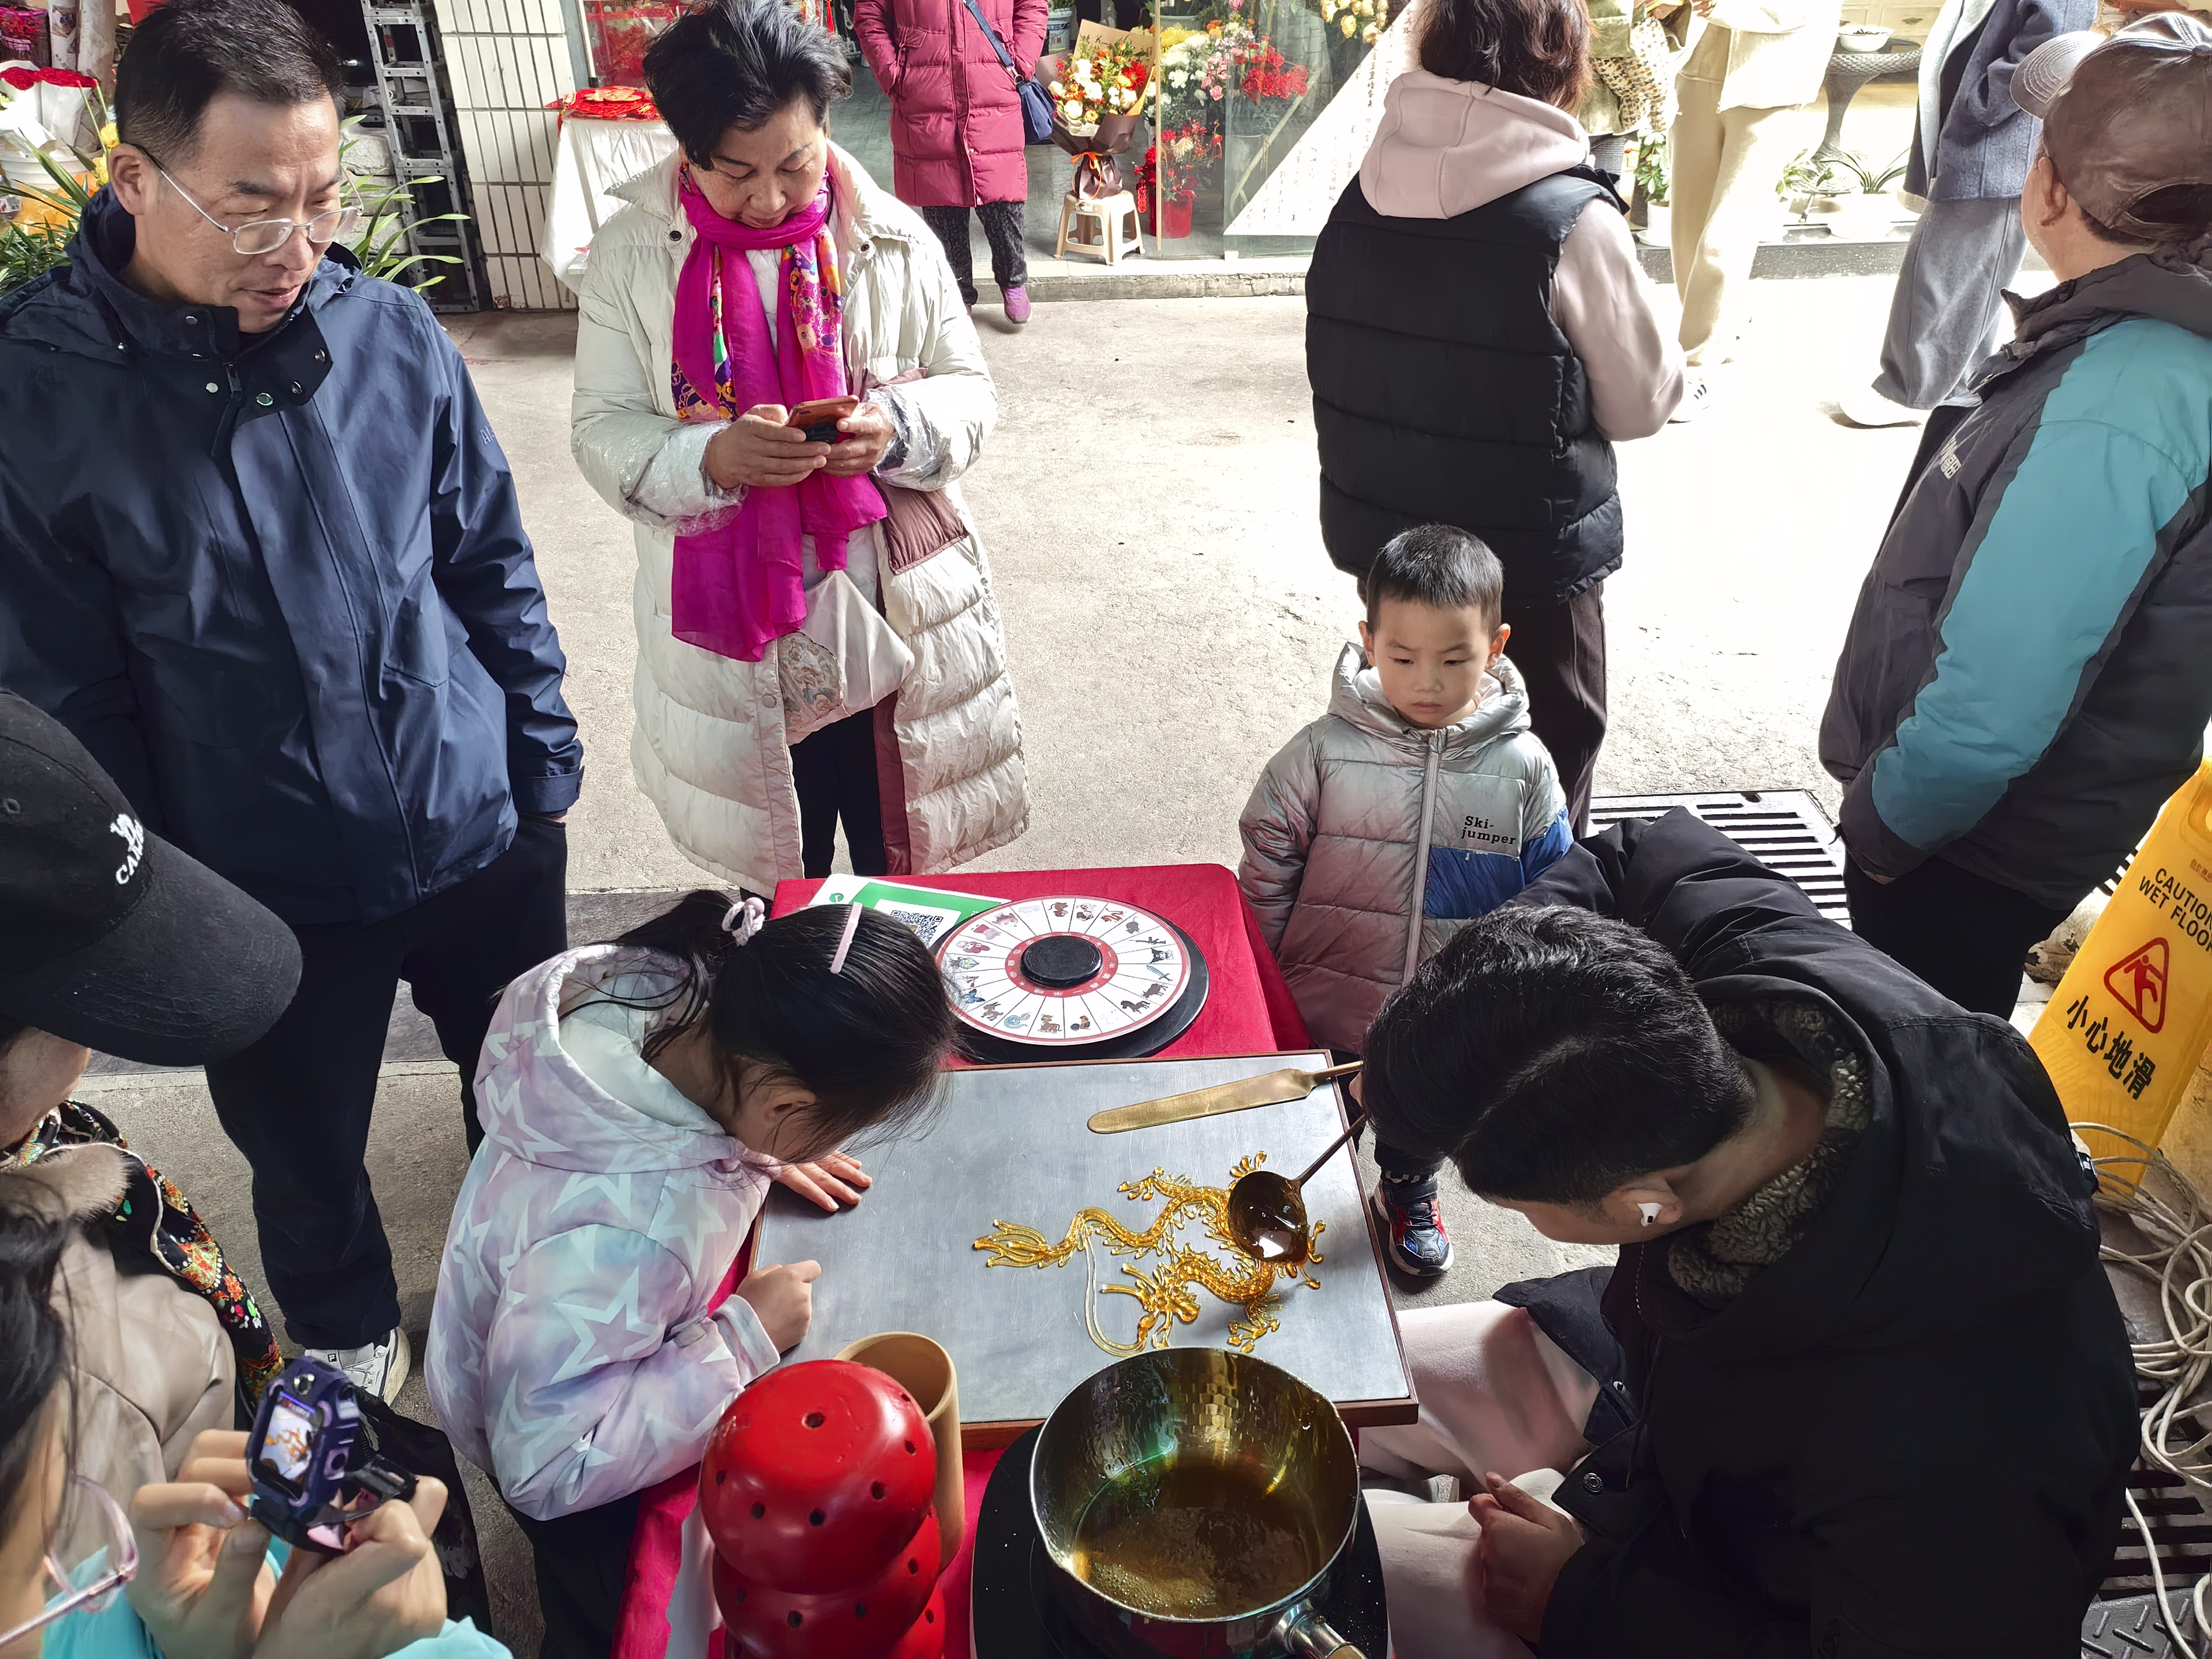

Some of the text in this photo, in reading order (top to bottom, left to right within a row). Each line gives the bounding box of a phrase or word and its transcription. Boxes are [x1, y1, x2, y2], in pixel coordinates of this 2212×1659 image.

[1465, 815, 1494, 829] Ski-
[1461, 827, 1516, 845] jumper
[2139, 875, 2170, 909] WET
[2067, 995, 2156, 1101] 小心地滑
